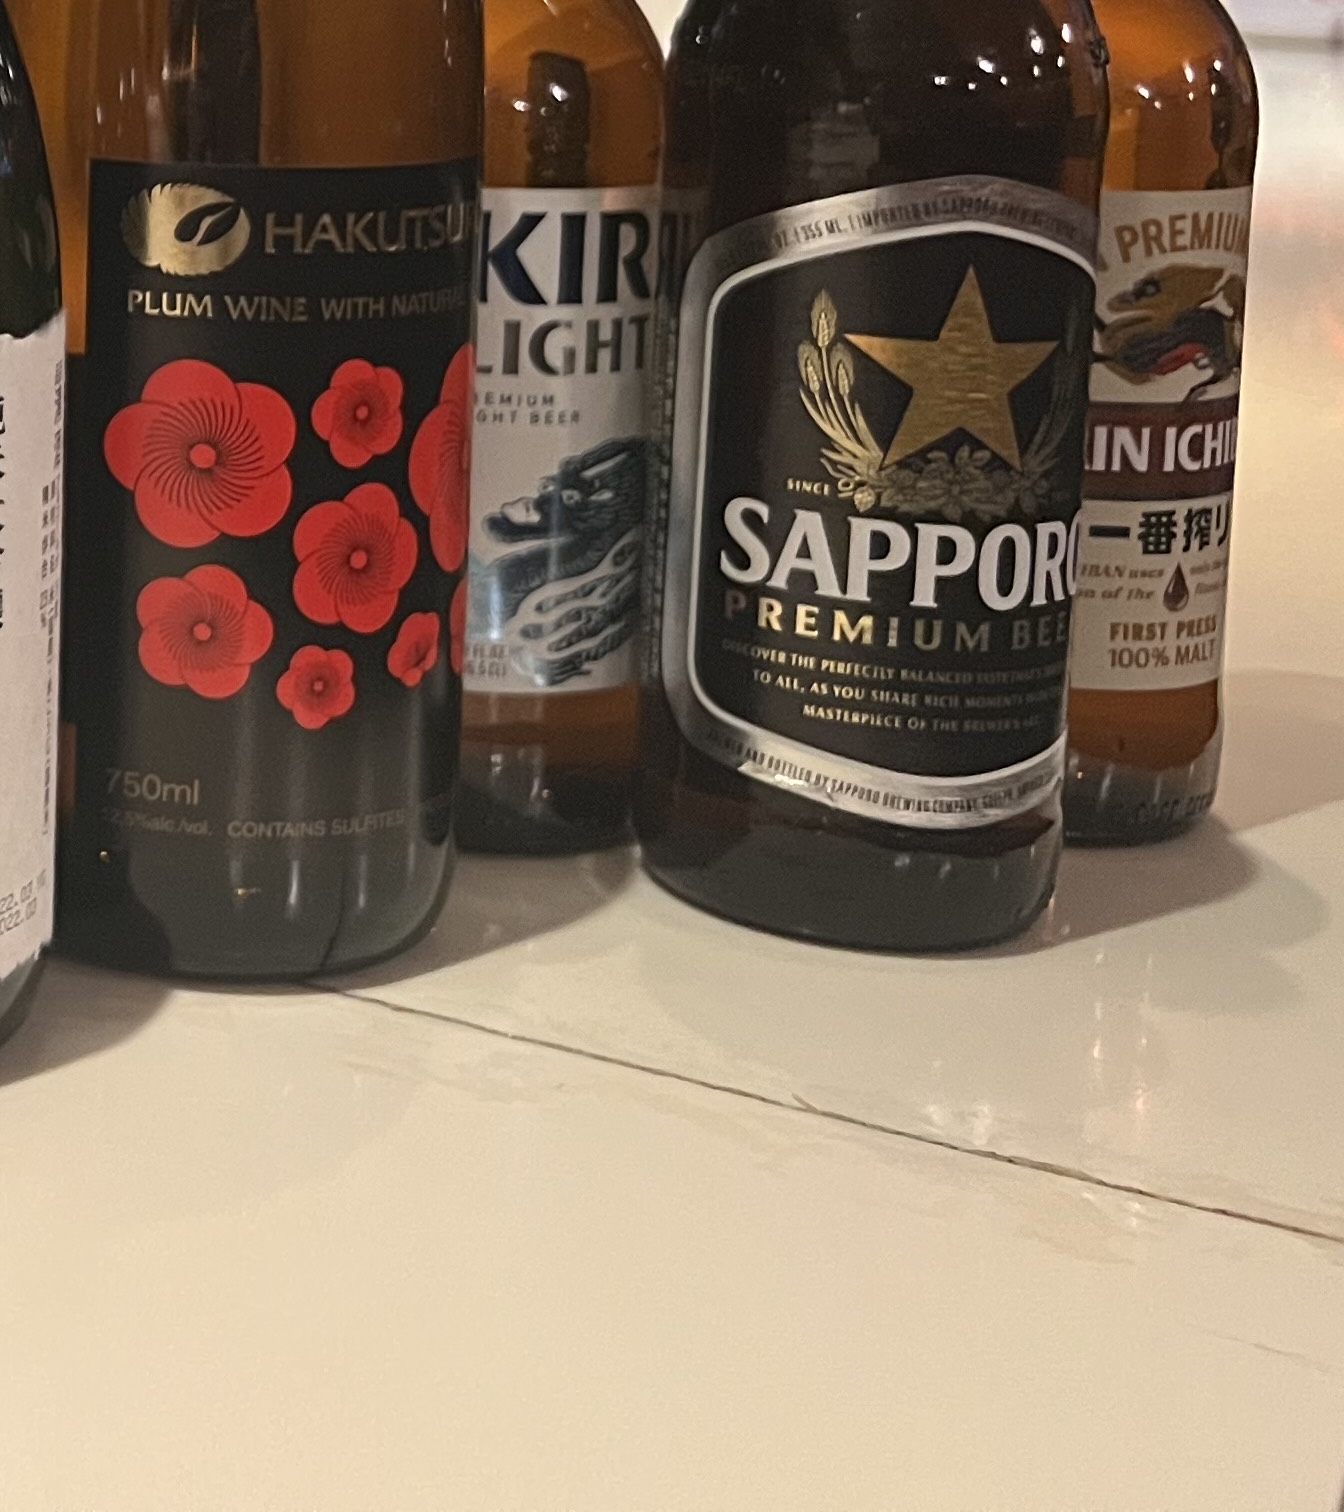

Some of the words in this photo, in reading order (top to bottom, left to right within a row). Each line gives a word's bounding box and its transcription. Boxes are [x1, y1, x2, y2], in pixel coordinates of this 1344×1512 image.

[127, 289, 213, 317] PLUM
[224, 295, 308, 322] WINE
[320, 296, 385, 322] WITH
[529, 410, 580, 425] BEER
[787, 477, 830, 495] SINCE
[1088, 502, 1230, 555] 一番搾り
[724, 590, 991, 653] PREMIUM
[1109, 620, 1169, 642] FIRST
[790, 652, 817, 671] THE
[1109, 646, 1170, 670] 100%
[752, 668, 772, 685] TO
[774, 675, 806, 694] ALL,
[810, 681, 829, 697] AS
[832, 683, 866, 701] YOU
[870, 689, 917, 707] SHARE
[801, 702, 902, 729] MASTERPIECE
[907, 716, 927, 731] OF
[767, 754, 813, 783] BOTTLED
[814, 772, 830, 788] BY
[107, 768, 200, 805] 750ml
[227, 819, 327, 838] CONTAINS
